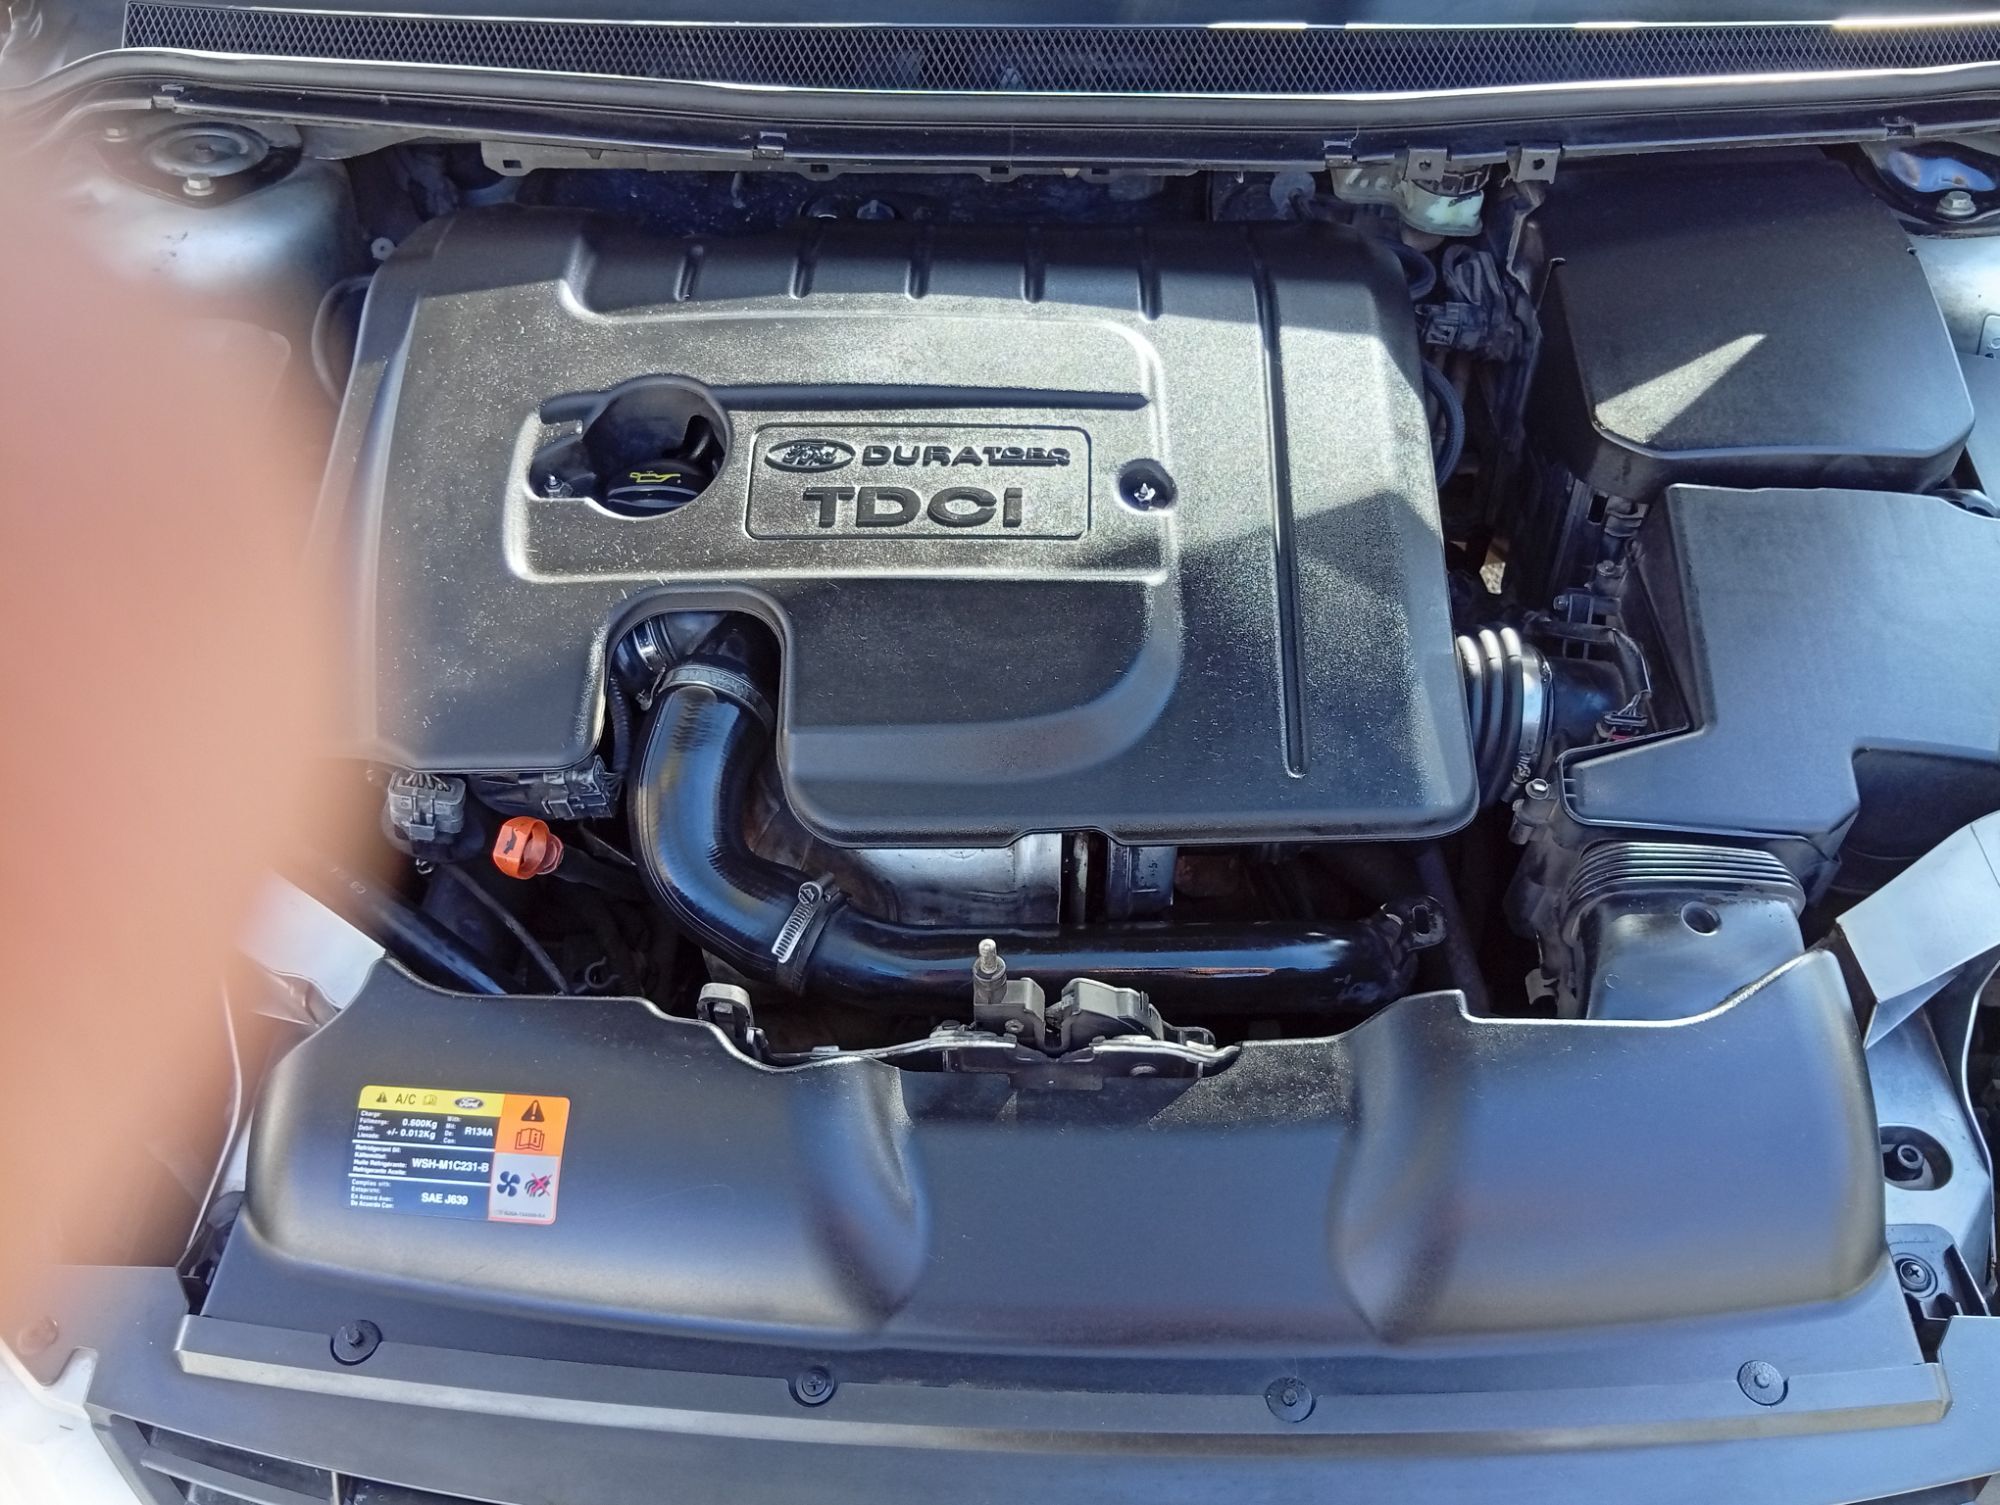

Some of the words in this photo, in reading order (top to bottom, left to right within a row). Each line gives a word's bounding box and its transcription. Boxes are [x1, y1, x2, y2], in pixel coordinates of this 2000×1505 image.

[394, 1093, 416, 1105] A/C
[402, 1118, 438, 1130] 0.600Kg
[400, 1128, 436, 1140] 0.012Kg
[464, 1126, 494, 1137] R134A
[412, 1157, 490, 1173] WSH-M1C231-B
[421, 1192, 443, 1203] SAE
[444, 1194, 468, 1205] J639
